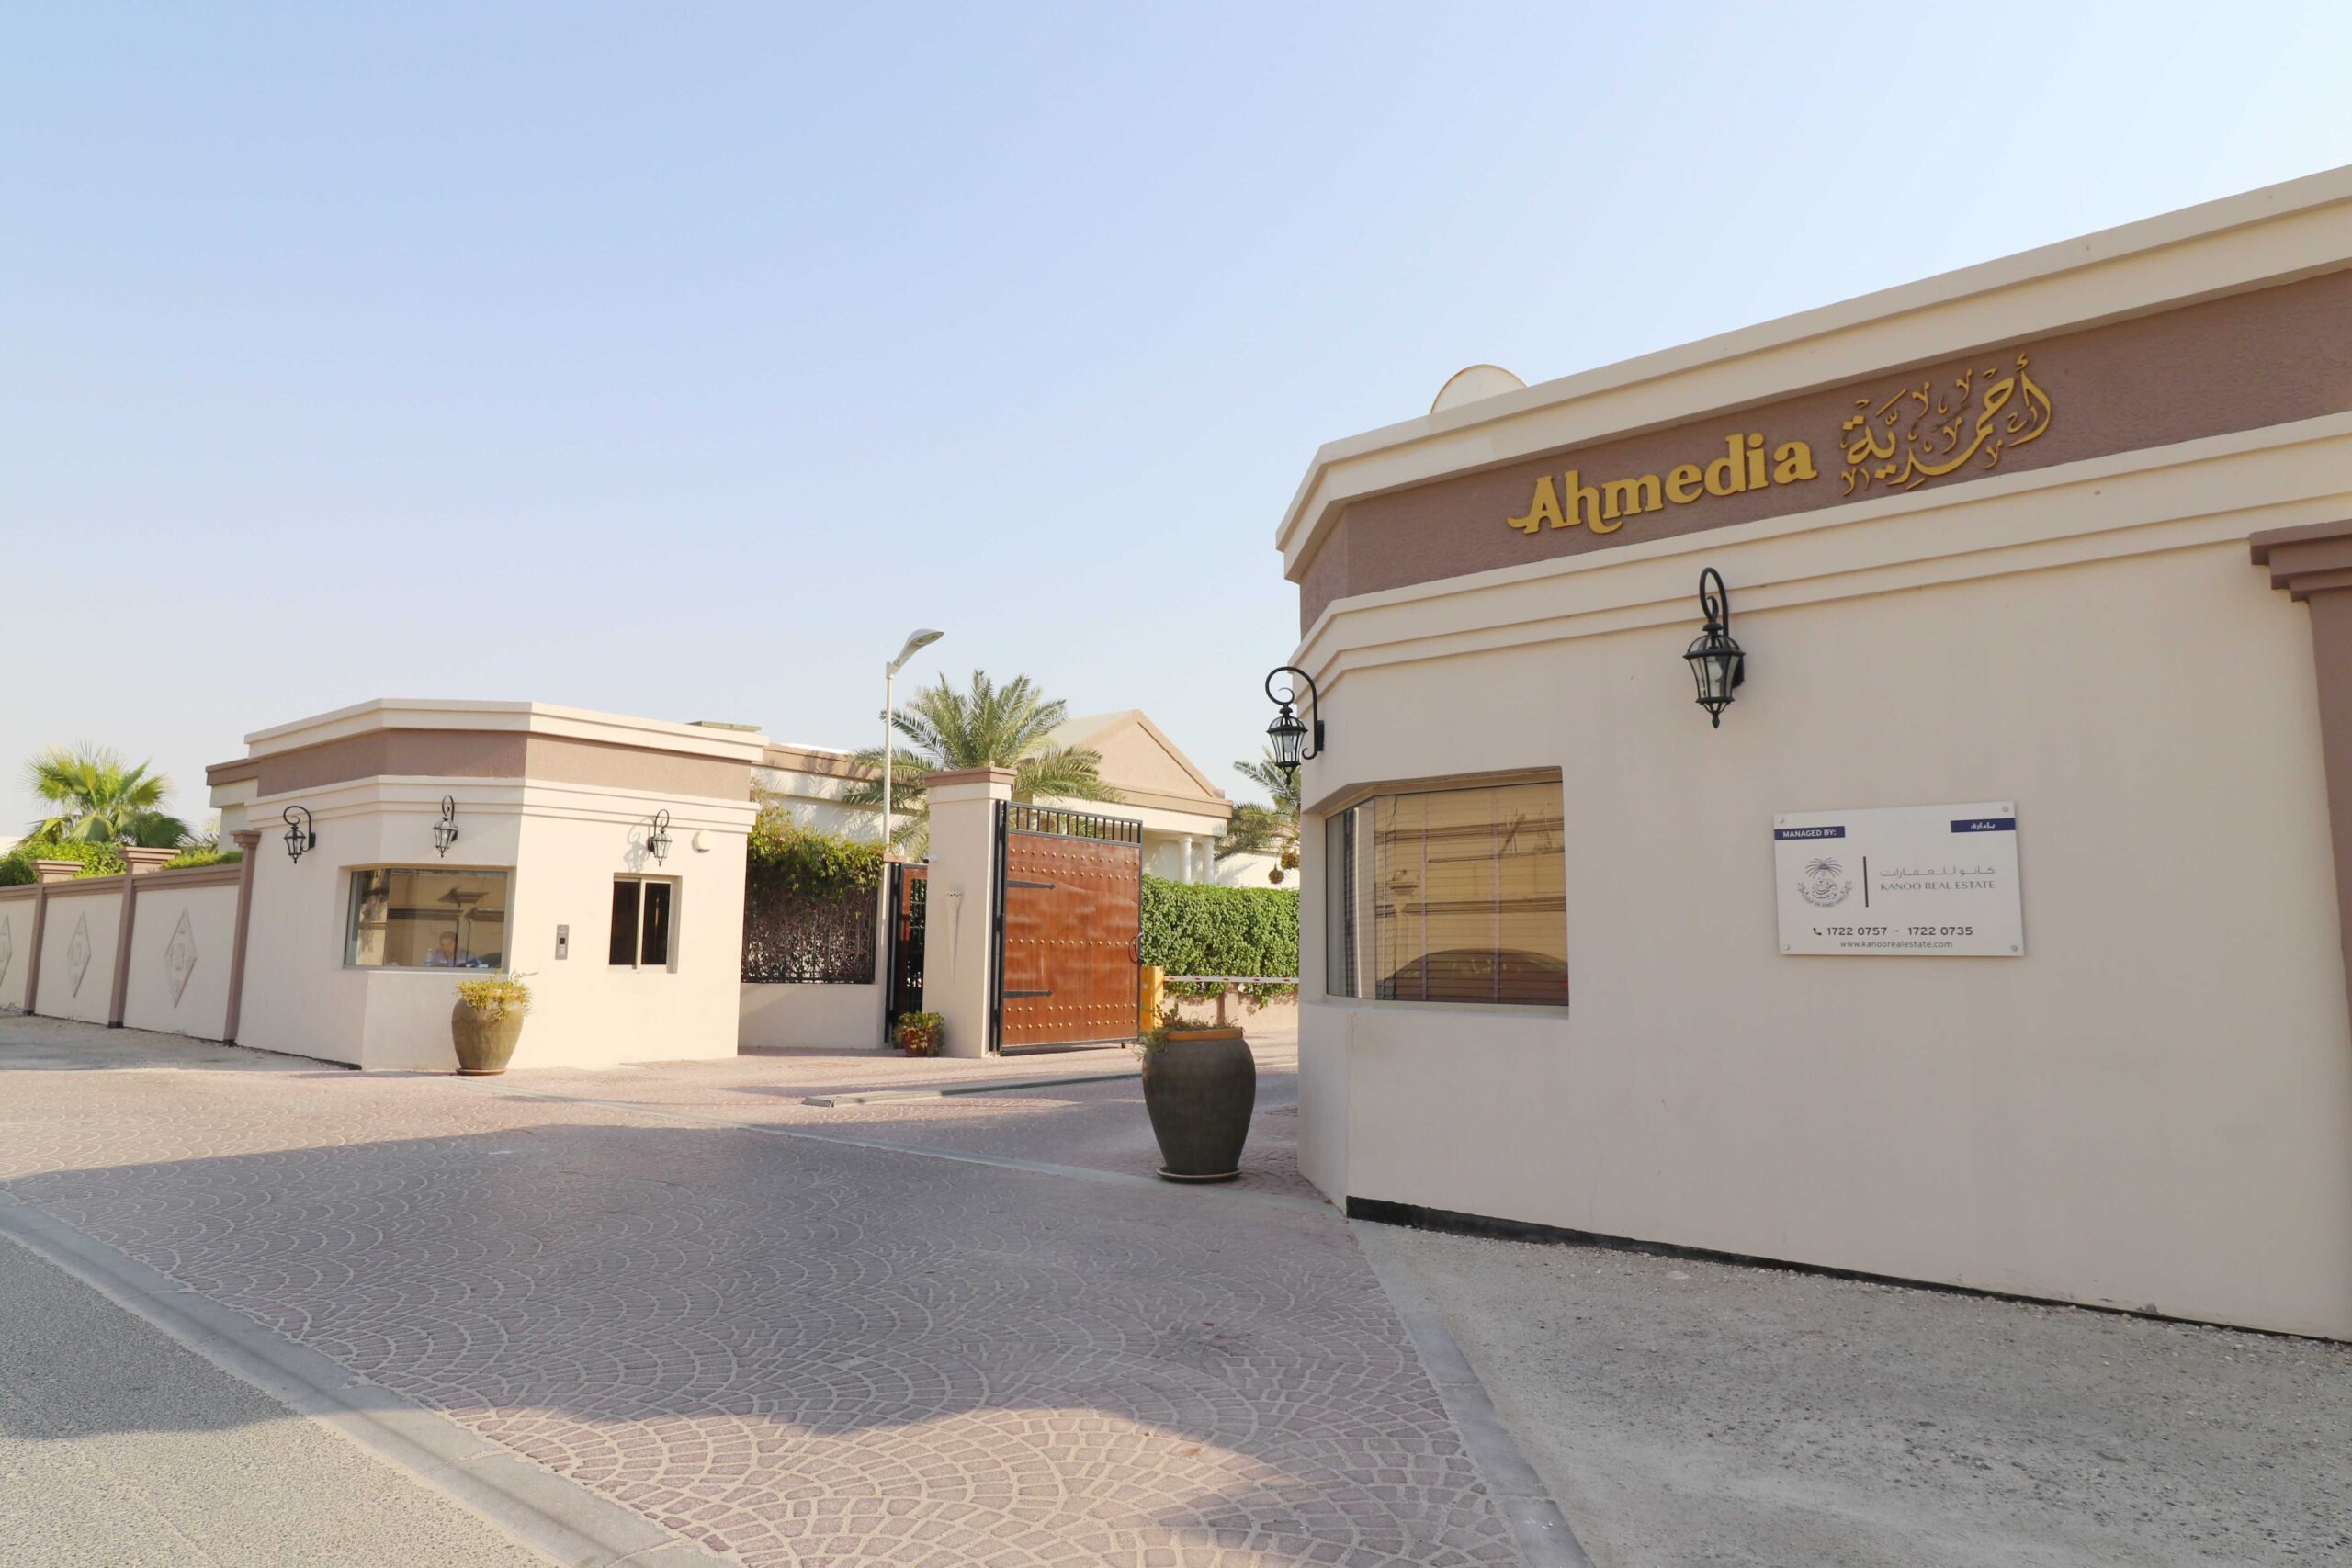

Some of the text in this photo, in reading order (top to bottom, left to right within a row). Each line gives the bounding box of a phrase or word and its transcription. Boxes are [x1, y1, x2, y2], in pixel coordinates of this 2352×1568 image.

[1507, 433, 1818, 535] Ahmedia
[1782, 829, 1822, 839] MANAGED
[1880, 865, 1996, 879] كانو للعقارات
[1880, 880, 1996, 891] KANOO REAL ESTATE
[1826, 927, 1853, 936] 1722
[1857, 927, 1888, 936] 0757
[1908, 927, 1937, 936] 1722
[1940, 926, 1973, 936] 0735
[1840, 940, 1953, 948] www.kanoorealestate.com
